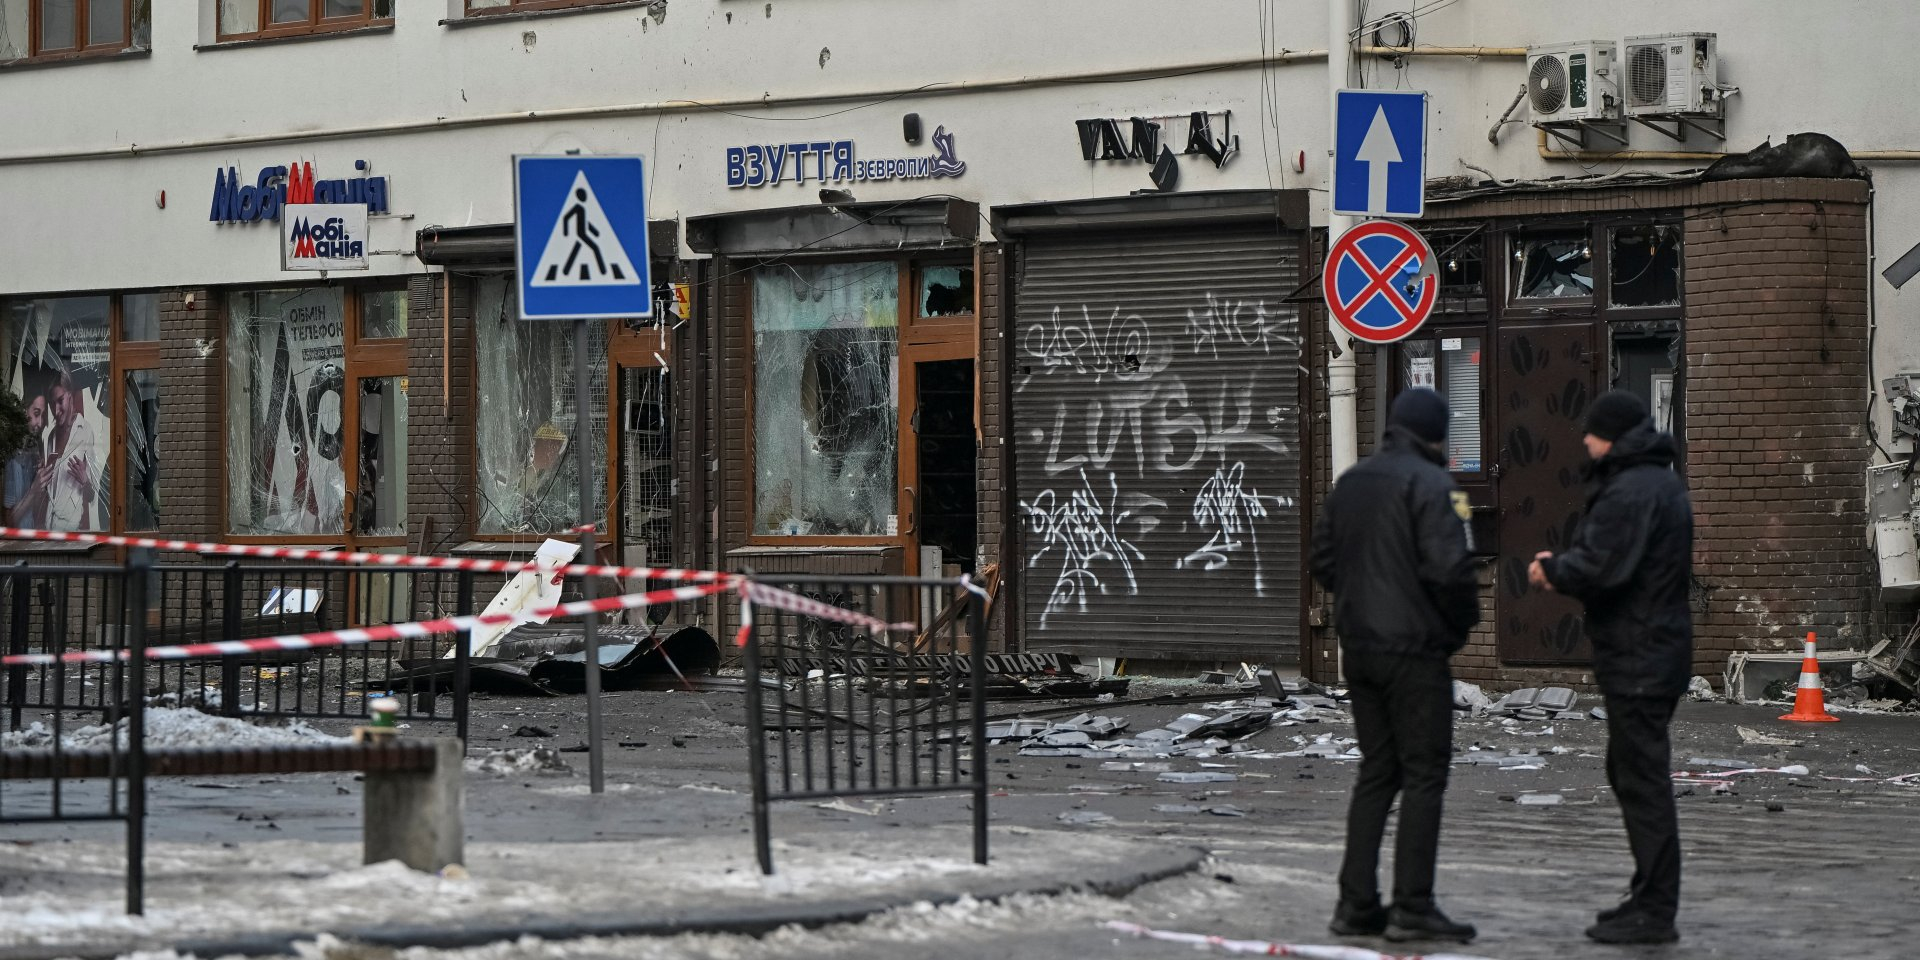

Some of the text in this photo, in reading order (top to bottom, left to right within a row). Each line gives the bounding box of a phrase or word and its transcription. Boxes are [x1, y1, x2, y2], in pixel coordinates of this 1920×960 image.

[726, 139, 854, 188] ВЗУТТЯ
[291, 215, 344, 242] Мобі
[294, 234, 363, 258] Манія
[290, 305, 326, 323] ОБМІН
[1000, 653, 1062, 673] ПАРУ
